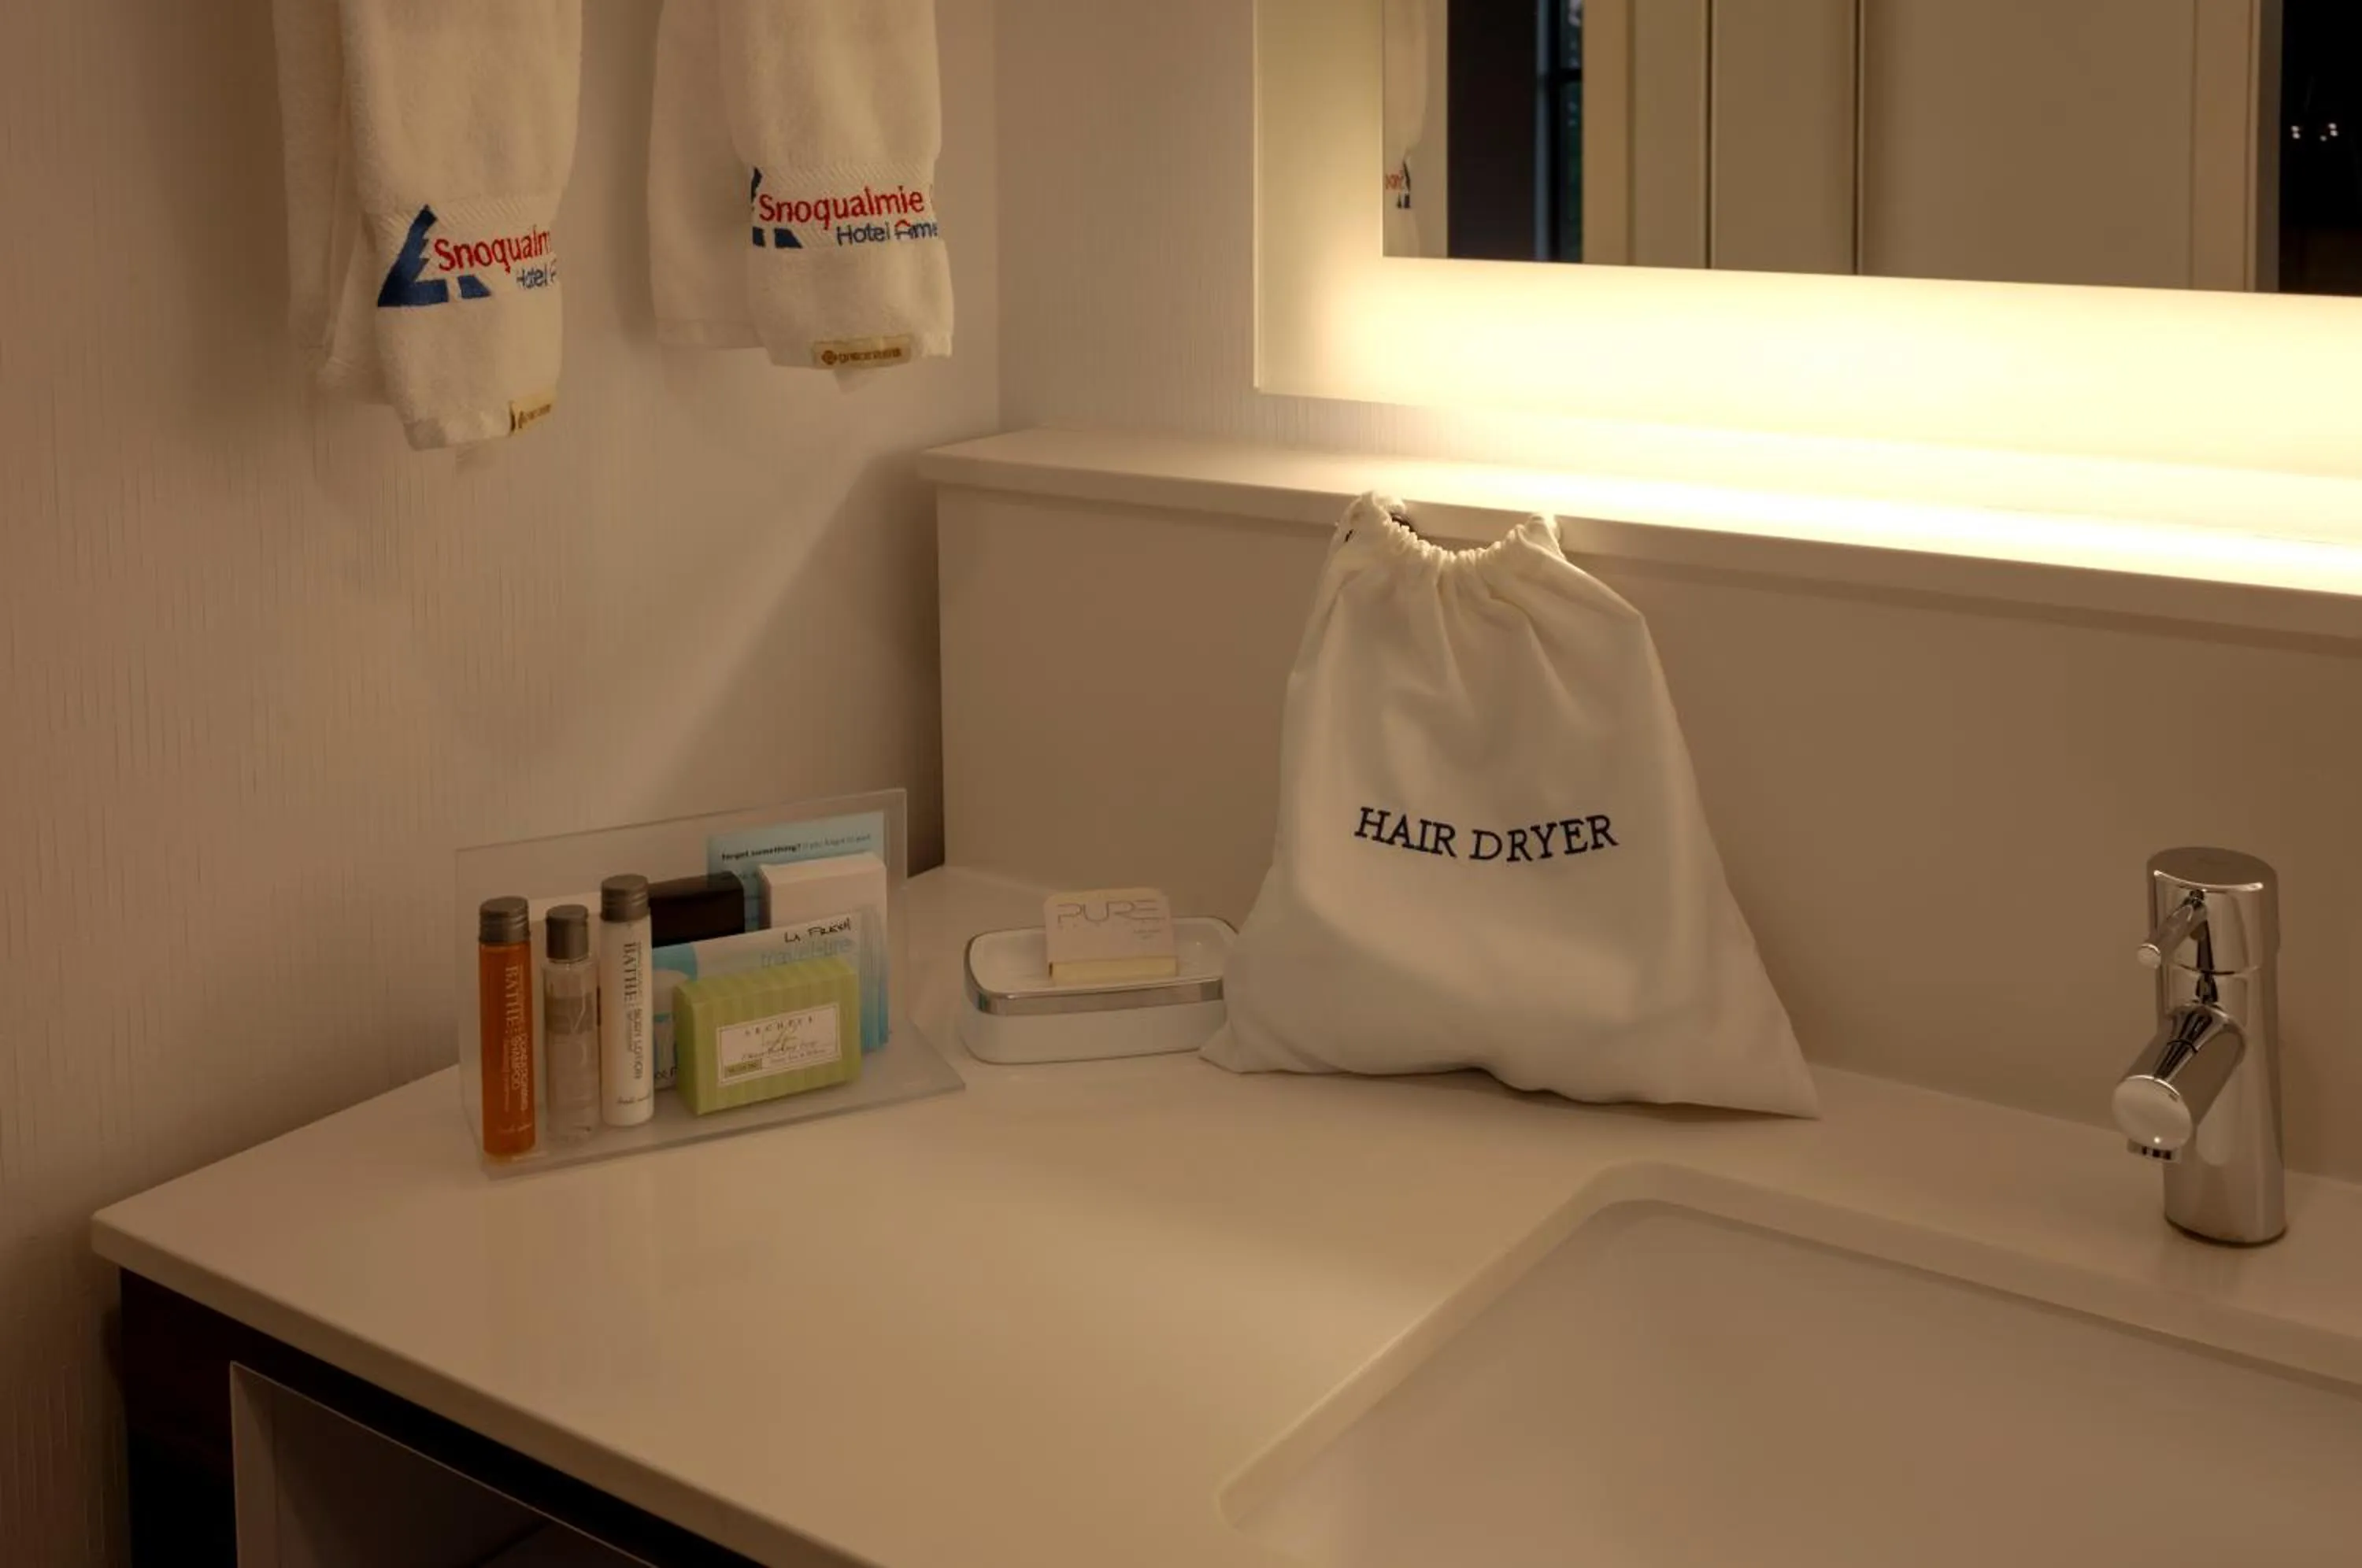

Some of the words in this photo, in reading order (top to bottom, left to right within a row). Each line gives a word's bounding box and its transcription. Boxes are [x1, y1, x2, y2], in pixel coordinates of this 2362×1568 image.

[758, 185, 925, 230] Snoqualmie
[836, 220, 890, 246] Hotel
[1354, 807, 1457, 858] HAIR
[1469, 814, 1619, 863] DRYER
[1057, 899, 1165, 924] PURE
